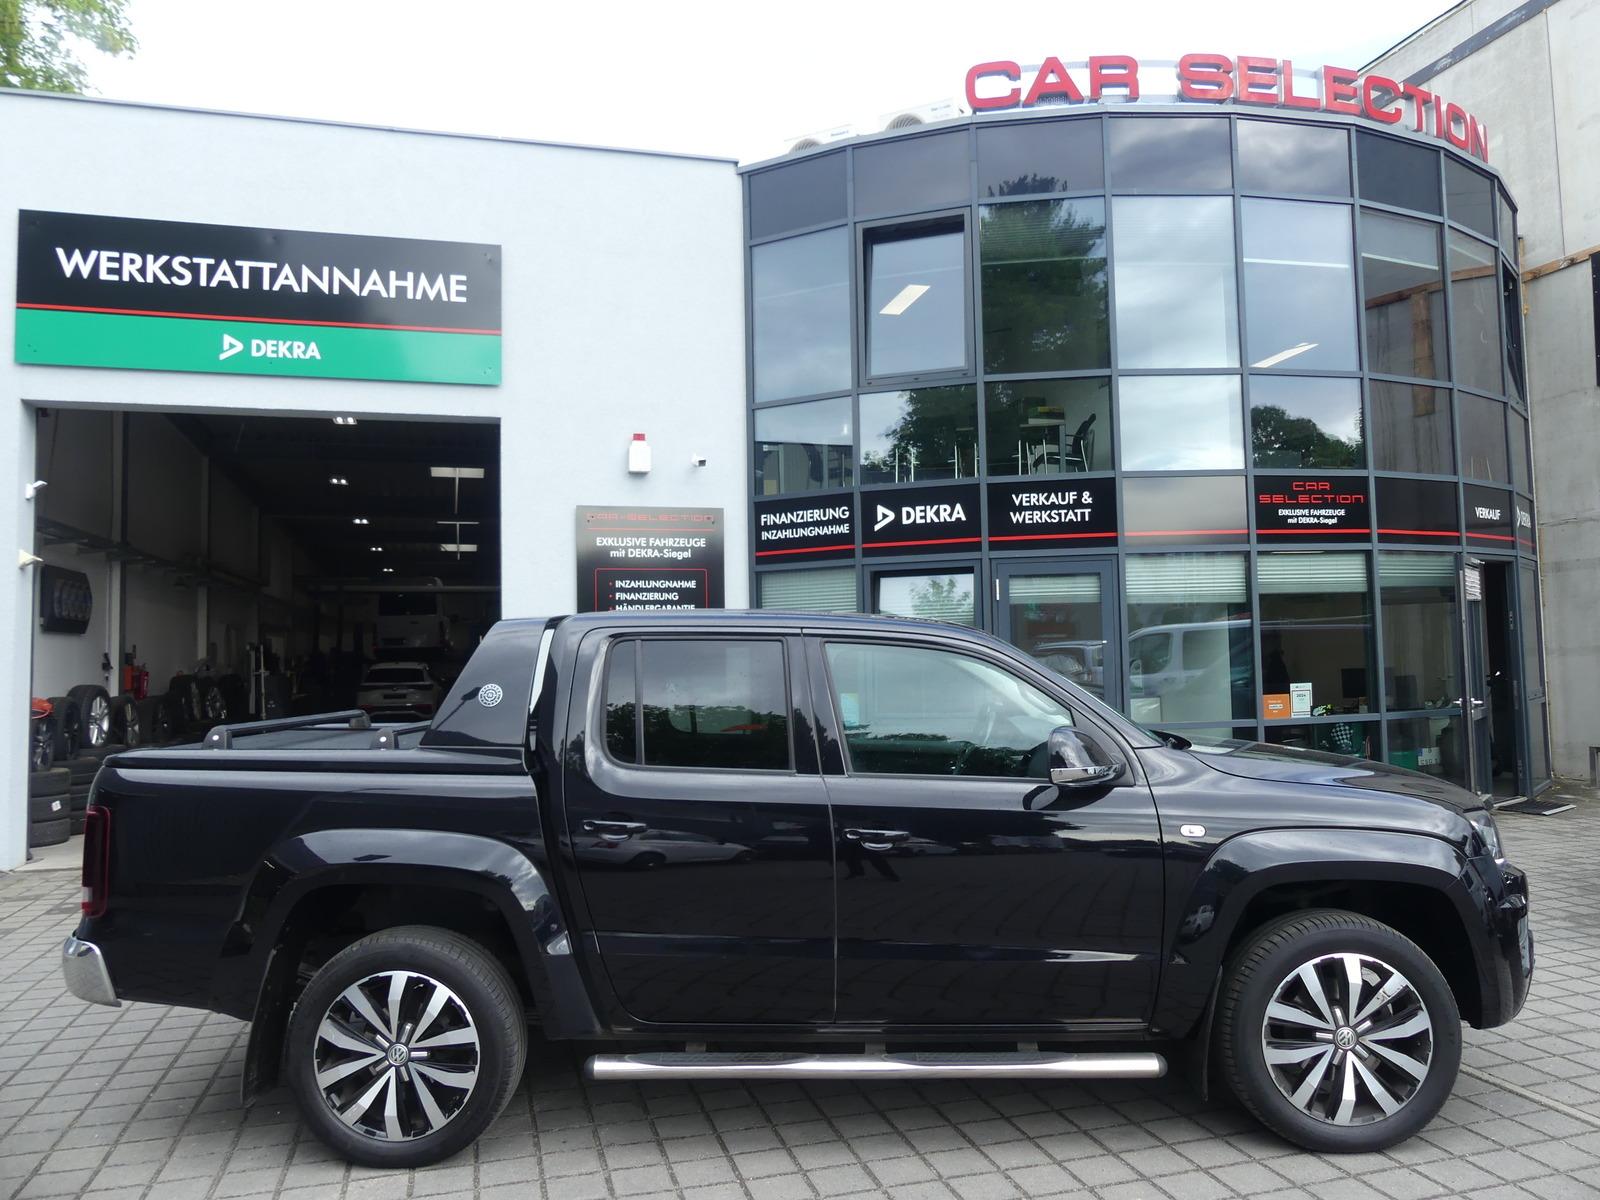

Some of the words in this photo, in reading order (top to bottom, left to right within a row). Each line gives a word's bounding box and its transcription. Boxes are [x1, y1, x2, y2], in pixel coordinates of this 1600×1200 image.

[965, 55, 1140, 113] CAR
[1176, 53, 1490, 164] SELECTION
[55, 247, 468, 303] WERKSTATTANNAHME
[251, 339, 322, 360] DEKRA
[1292, 481, 1331, 491] CAR
[1012, 492, 1078, 507] VERKAUF
[1081, 491, 1093, 504] &
[1259, 494, 1364, 504] SELECTION
[760, 506, 850, 526] FINANZIERUNG
[902, 503, 966, 525] DEKRA
[1009, 508, 1092, 524] WERKSTATT
[1278, 508, 1309, 517] EXKLUSIVE
[1310, 508, 1346, 517] FAHRZEUGE
[1474, 506, 1501, 520] VERKAUF
[1287, 517, 1297, 525] mit
[761, 523, 850, 541] INZAHLUNGNAHME
[596, 537, 647, 547] EXKLUSIVE
[649, 538, 706, 548] FAHRZEUGE
[610, 548, 626, 558] mit
[628, 548, 692, 560] DEKRA-Siegel
[615, 580, 697, 588] INZAHLUNGNAHME
[615, 592, 679, 601] FINANZIERUNG
